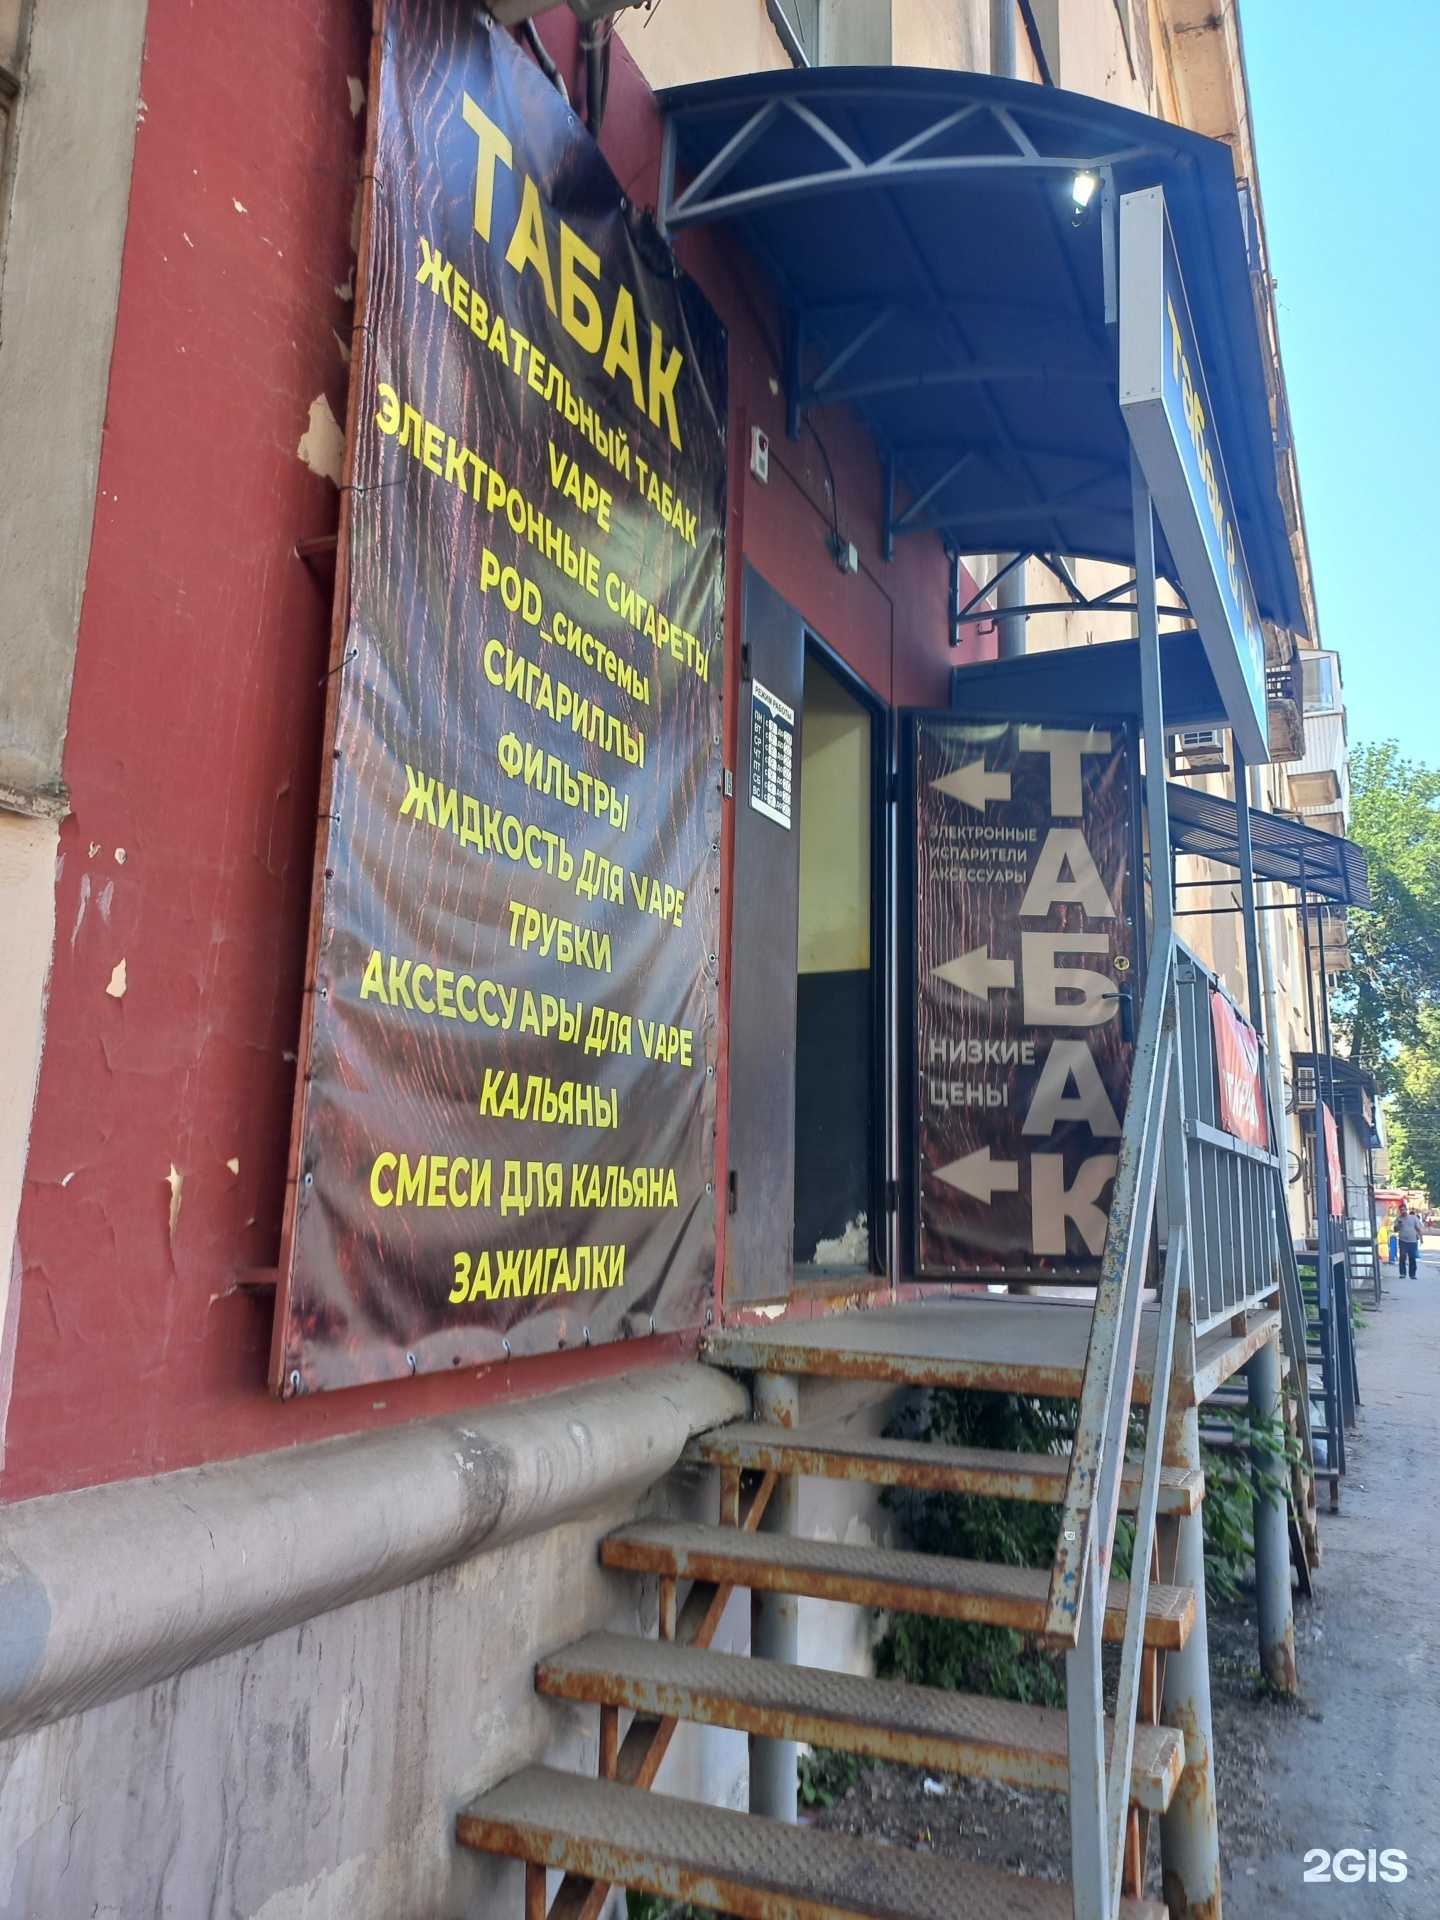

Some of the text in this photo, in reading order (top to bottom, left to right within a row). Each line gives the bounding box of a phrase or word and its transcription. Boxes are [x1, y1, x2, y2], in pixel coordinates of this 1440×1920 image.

[463, 91, 682, 452] ТАБАК
[415, 236, 697, 548] ЖЕВАТЕЛЬНЫЙ ТАБАК
[548, 441, 612, 534] VAPE
[375, 383, 709, 682] ЭЛЕКТРОННЫЕ СИГАРЕТЫ
[483, 638, 645, 768] СИГАРИЛЛЫ
[497, 731, 630, 833] ФИЛЬТРЫ
[400, 764, 685, 928] ЖИДКОСТЬ ДЛЯ VAPE
[929, 825, 1037, 841] ЭЛЕКТРОННЫЕ
[929, 846, 1027, 862] ИСПАРИТЕЛИ
[929, 868, 1027, 884] АКСЕССУАРЫ
[508, 900, 612, 973] ТРУБКИ
[359, 950, 693, 1067] АКСЕССУАРЫ ДЛЯ VAPE
[1019, 729, 1122, 1256] ТАБАК
[930, 1040, 1036, 1066] НИЗКИЕ
[479, 1068, 618, 1129] КАЛЬЯНЫ
[930, 1082, 1008, 1109] ЦЕНЫ
[369, 1151, 679, 1216] СМЕСИ ДЛЯ КАЛЬЯНА
[448, 1244, 626, 1304] ЗАЖИГАЛКИ
